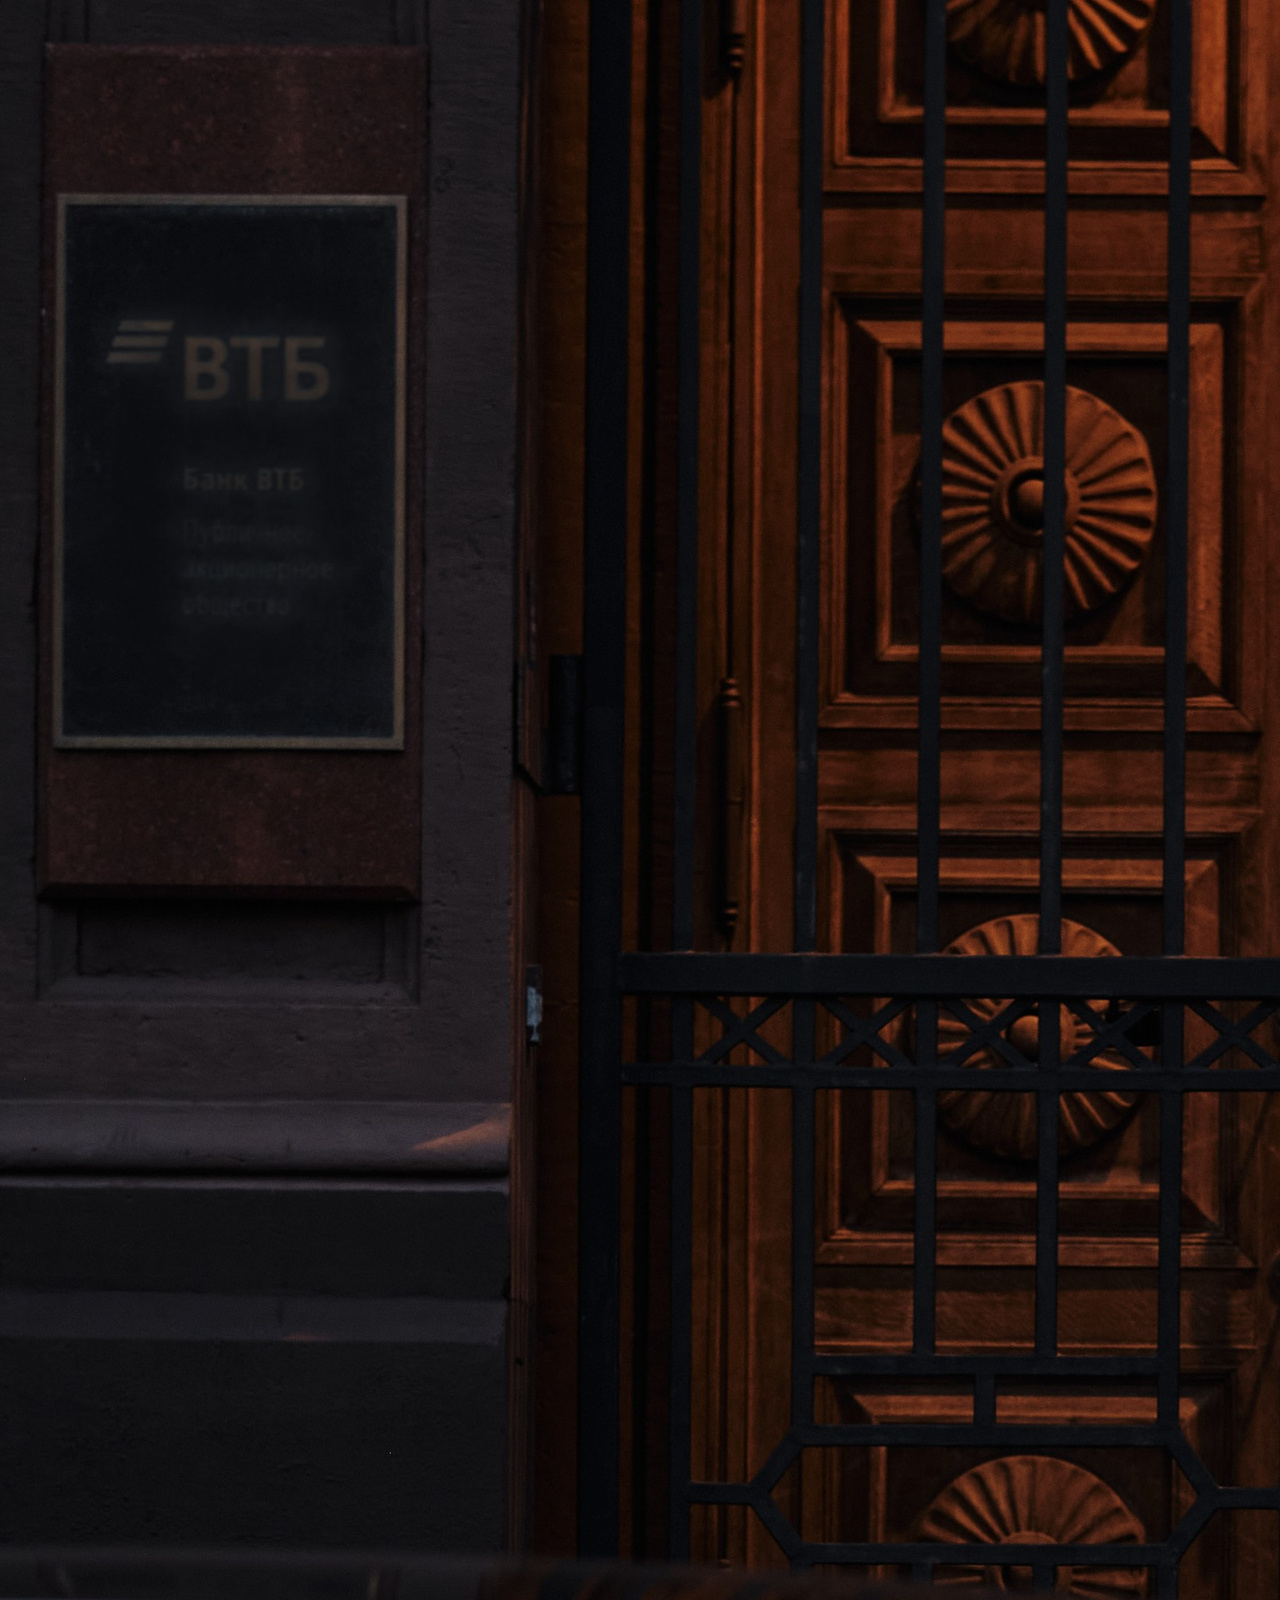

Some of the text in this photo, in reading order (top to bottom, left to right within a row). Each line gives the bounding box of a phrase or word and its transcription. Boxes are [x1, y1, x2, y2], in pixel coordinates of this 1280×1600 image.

[184, 336, 330, 401] ВТБ
[183, 467, 305, 491] Банк ВТБ
